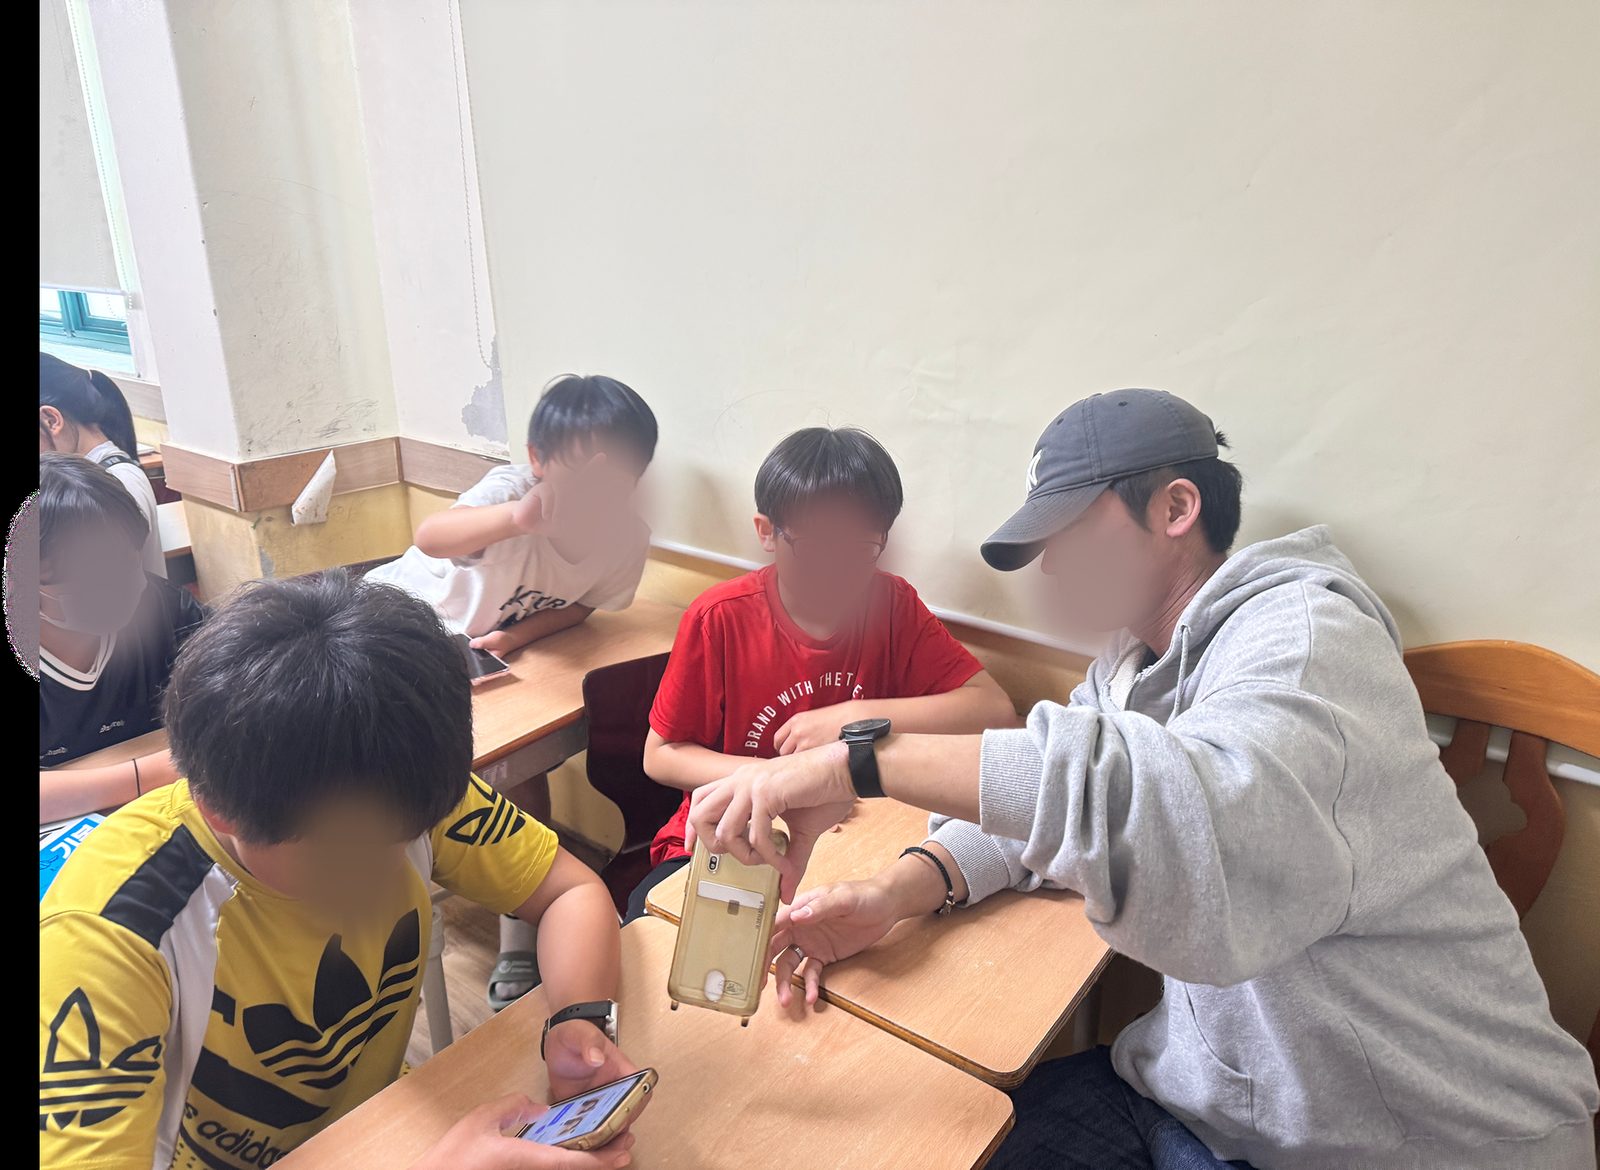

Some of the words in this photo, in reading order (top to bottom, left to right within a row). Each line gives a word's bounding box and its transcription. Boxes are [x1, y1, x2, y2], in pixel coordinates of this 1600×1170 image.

[745, 705, 777, 749] BRAND
[777, 680, 814, 706] WITH
[819, 672, 842, 689] THE
